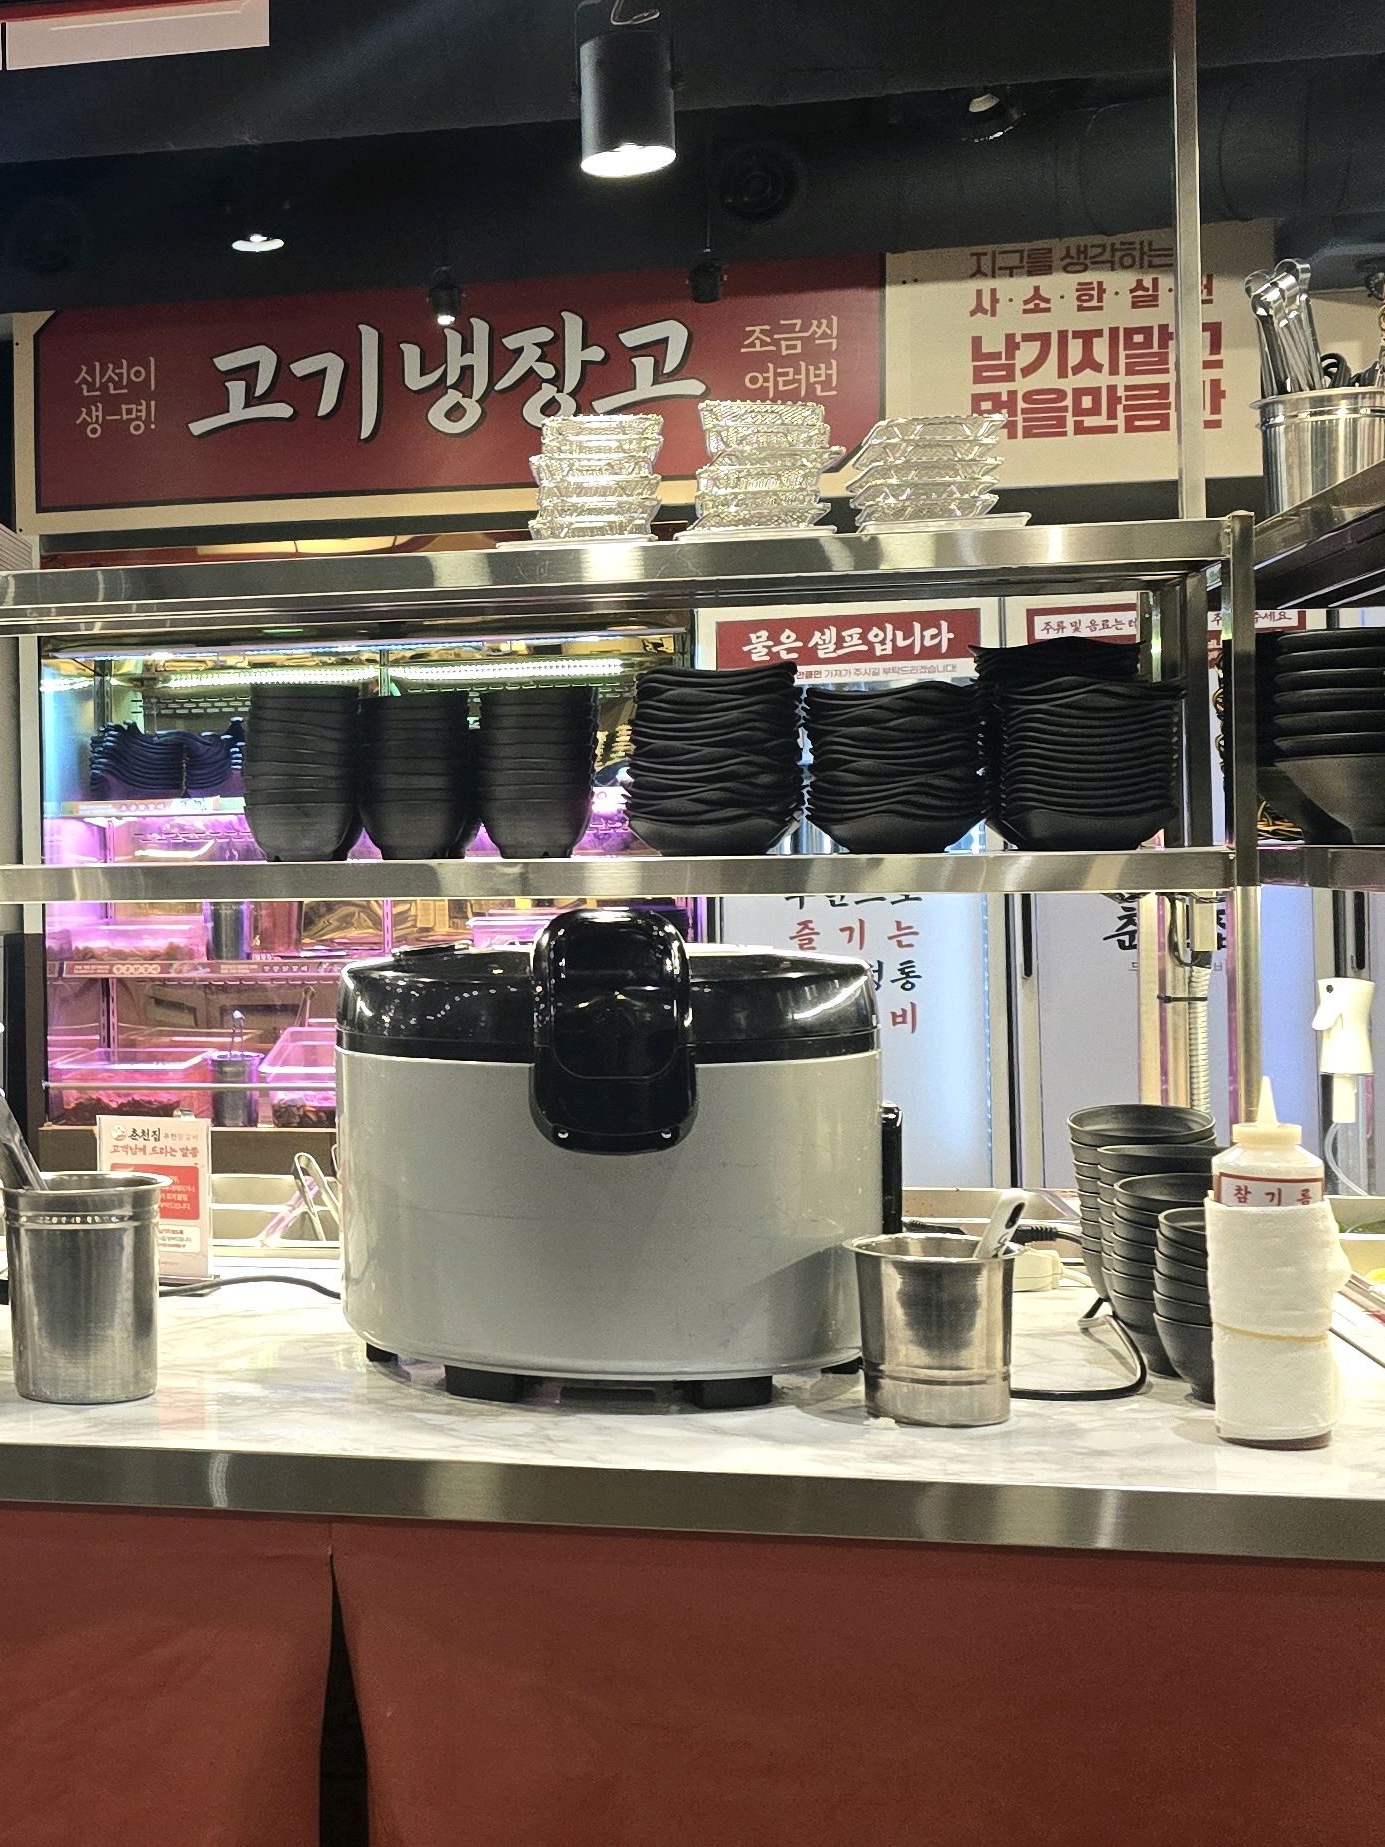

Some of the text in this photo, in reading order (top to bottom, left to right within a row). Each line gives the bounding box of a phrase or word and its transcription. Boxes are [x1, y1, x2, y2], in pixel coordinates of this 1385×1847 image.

[969, 240, 1175, 279] 지구를 생각하는
[740, 314, 838, 356] 조금씩
[74, 356, 156, 397] 신선이
[187, 310, 709, 441] 고기냉장고
[743, 358, 839, 400] 여러번
[742, 620, 955, 662] 물은 셀프입니다
[1040, 620, 1067, 635] 주류
[1070, 619, 1082, 633] 및
[1086, 617, 1125, 632] 음료는
